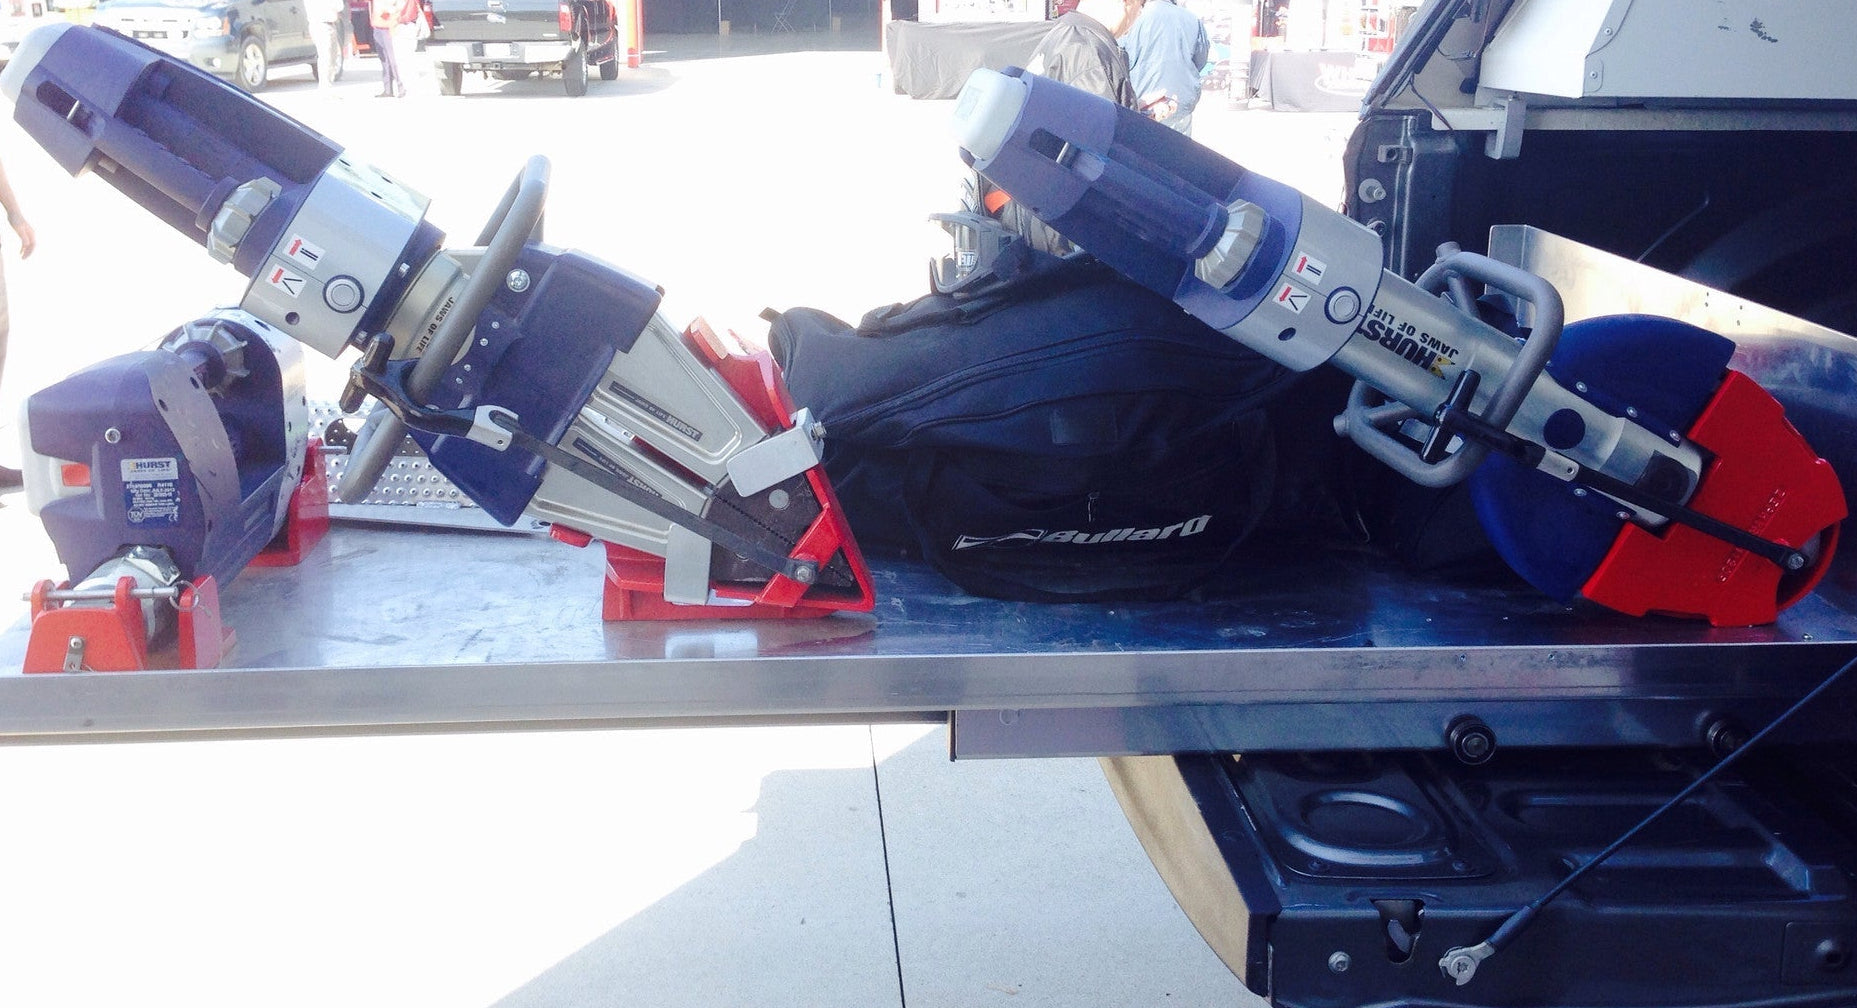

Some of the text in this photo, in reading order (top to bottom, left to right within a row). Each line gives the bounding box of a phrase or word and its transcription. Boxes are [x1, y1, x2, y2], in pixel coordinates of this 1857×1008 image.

[436, 296, 455, 322] JAWS
[427, 323, 438, 336] OF
[1396, 321, 1416, 337] OF
[1419, 332, 1459, 359] JAWS
[666, 414, 700, 439] HURST
[135, 461, 171, 469] HURST
[1040, 514, 1212, 544] Bullard
